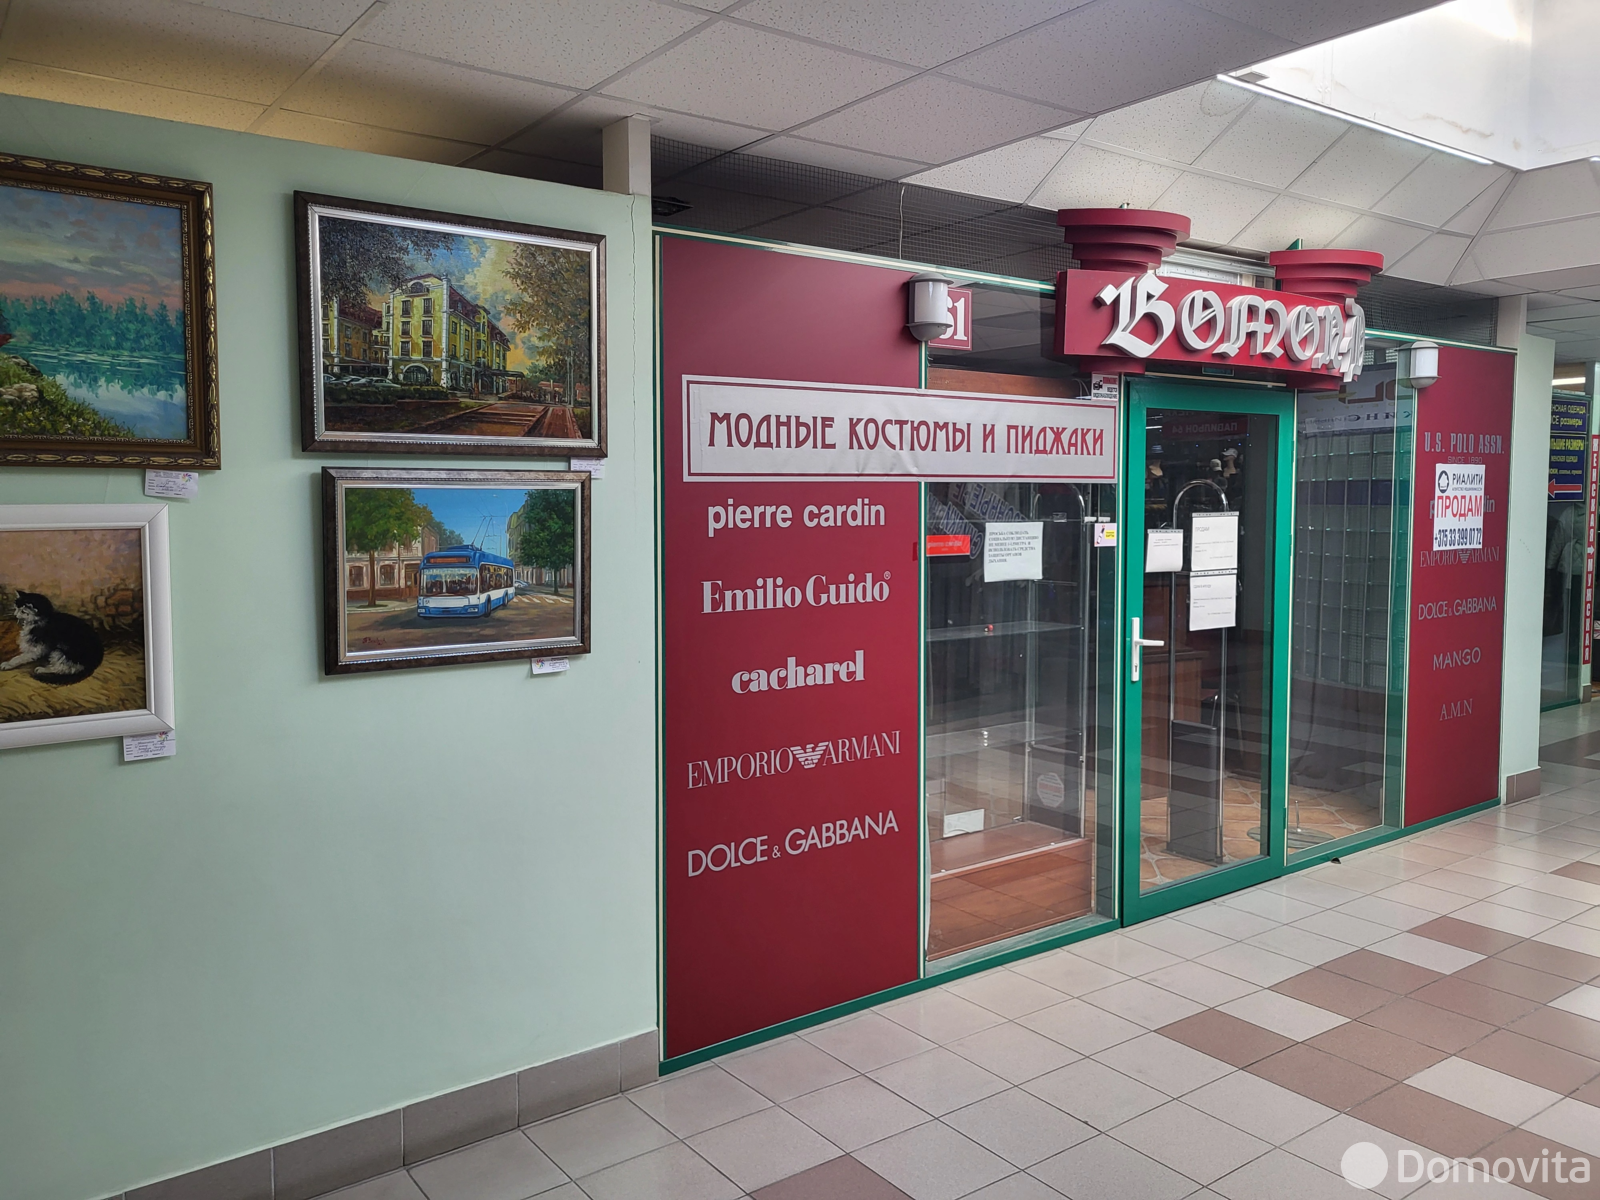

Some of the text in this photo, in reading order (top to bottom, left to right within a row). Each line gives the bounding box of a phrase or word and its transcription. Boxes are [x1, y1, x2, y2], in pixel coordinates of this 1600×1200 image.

[708, 412, 1104, 456] МОДНЫЕ КОСТЮМЫ И ПИДЖАКИ
[1424, 432, 1505, 454] U.S. POLO ASSN.
[1447, 456, 1465, 464] SINCE
[1452, 473, 1483, 486] РИАЛИТИ
[1589, 438, 1599, 542] ЖЕНСКАЯ
[708, 498, 885, 537] pierre cardin
[1436, 495, 1483, 522] ПРОДАМ
[1434, 529, 1448, 547] +375
[1449, 528, 1456, 546] 33
[1457, 528, 1468, 546] 399
[1420, 546, 1500, 567] EMPORIO ARMANI
[701, 577, 803, 614] Emilio
[1418, 600, 1448, 620] DOLCE
[1453, 596, 1497, 616] GABBANA
[1584, 558, 1593, 661] МУЖСКАЯ
[731, 650, 865, 694] cacharel
[1433, 647, 1481, 671] MANGO
[687, 730, 901, 789] EMPORIO ARMANI
[687, 810, 899, 877] DOLCE & GABBANA
